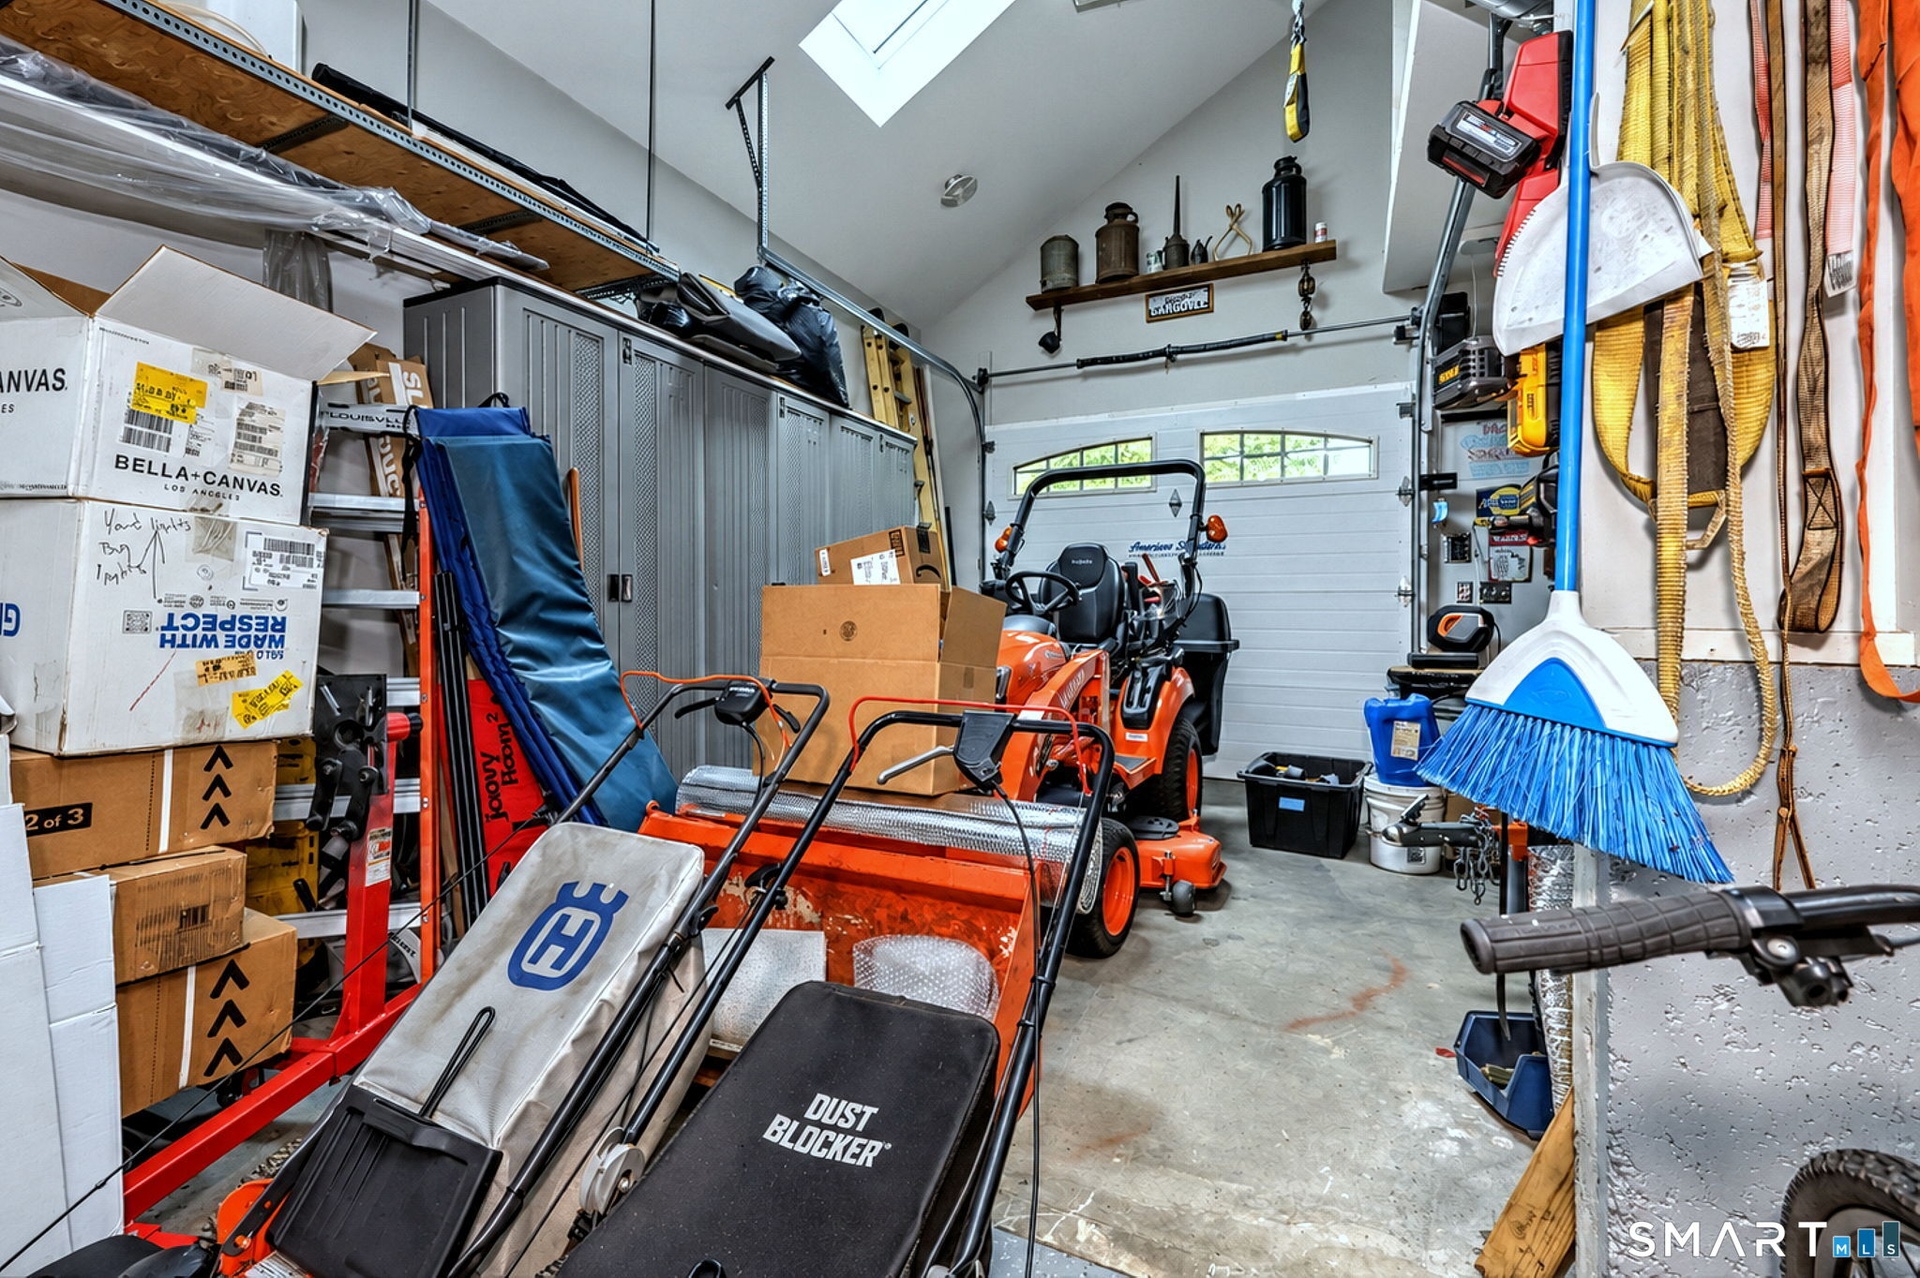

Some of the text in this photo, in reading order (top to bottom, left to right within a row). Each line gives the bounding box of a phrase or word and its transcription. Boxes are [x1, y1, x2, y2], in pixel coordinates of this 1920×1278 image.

[0, 368, 67, 393] NVAS.
[164, 484, 186, 493] LOS
[160, 612, 287, 633] RESPECT
[159, 633, 219, 649] WITH
[25, 807, 84, 831] 2 of 3
[803, 1092, 880, 1132] DUST
